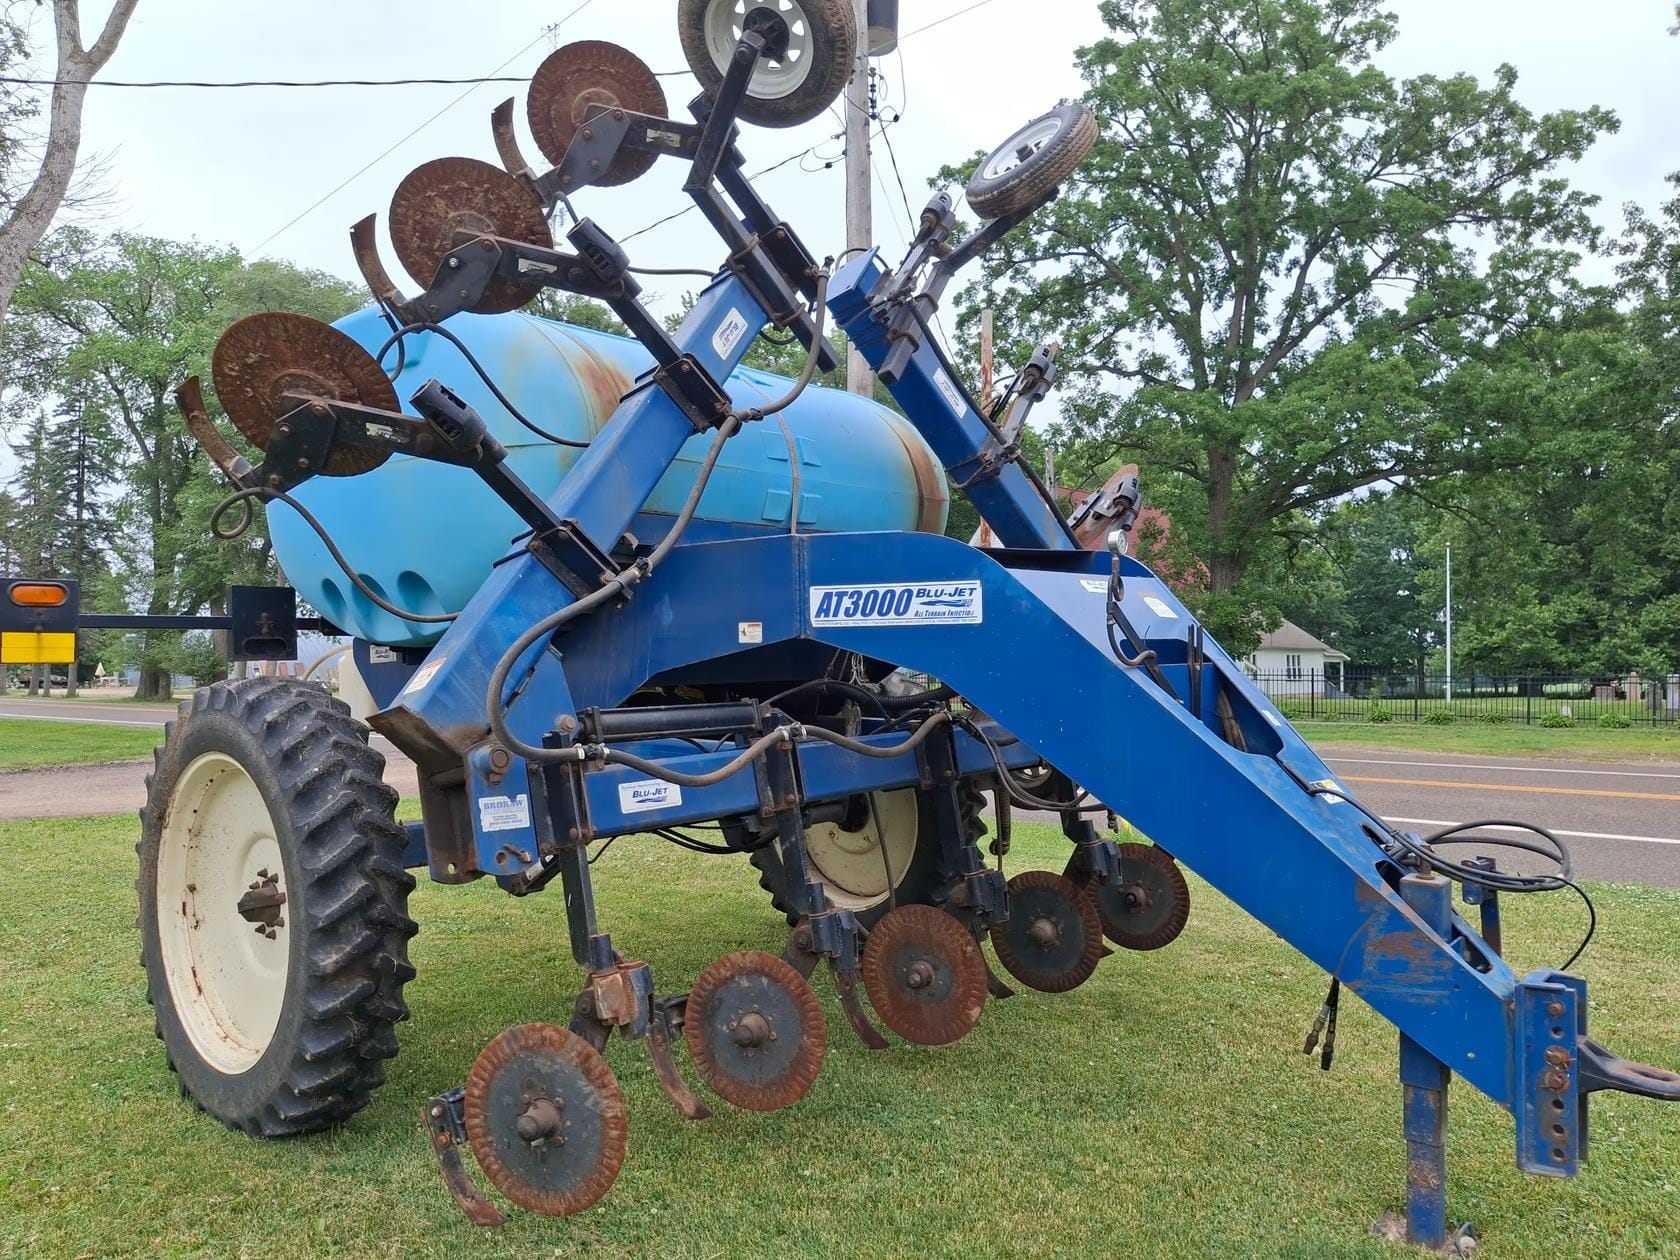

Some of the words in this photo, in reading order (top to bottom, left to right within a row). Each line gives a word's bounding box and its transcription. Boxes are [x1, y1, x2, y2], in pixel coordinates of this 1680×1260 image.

[915, 587, 977, 598] BLU-JET
[814, 588, 914, 618] AT3000
[632, 787, 668, 798] BLU-JET
[483, 799, 524, 810] BROKAW
